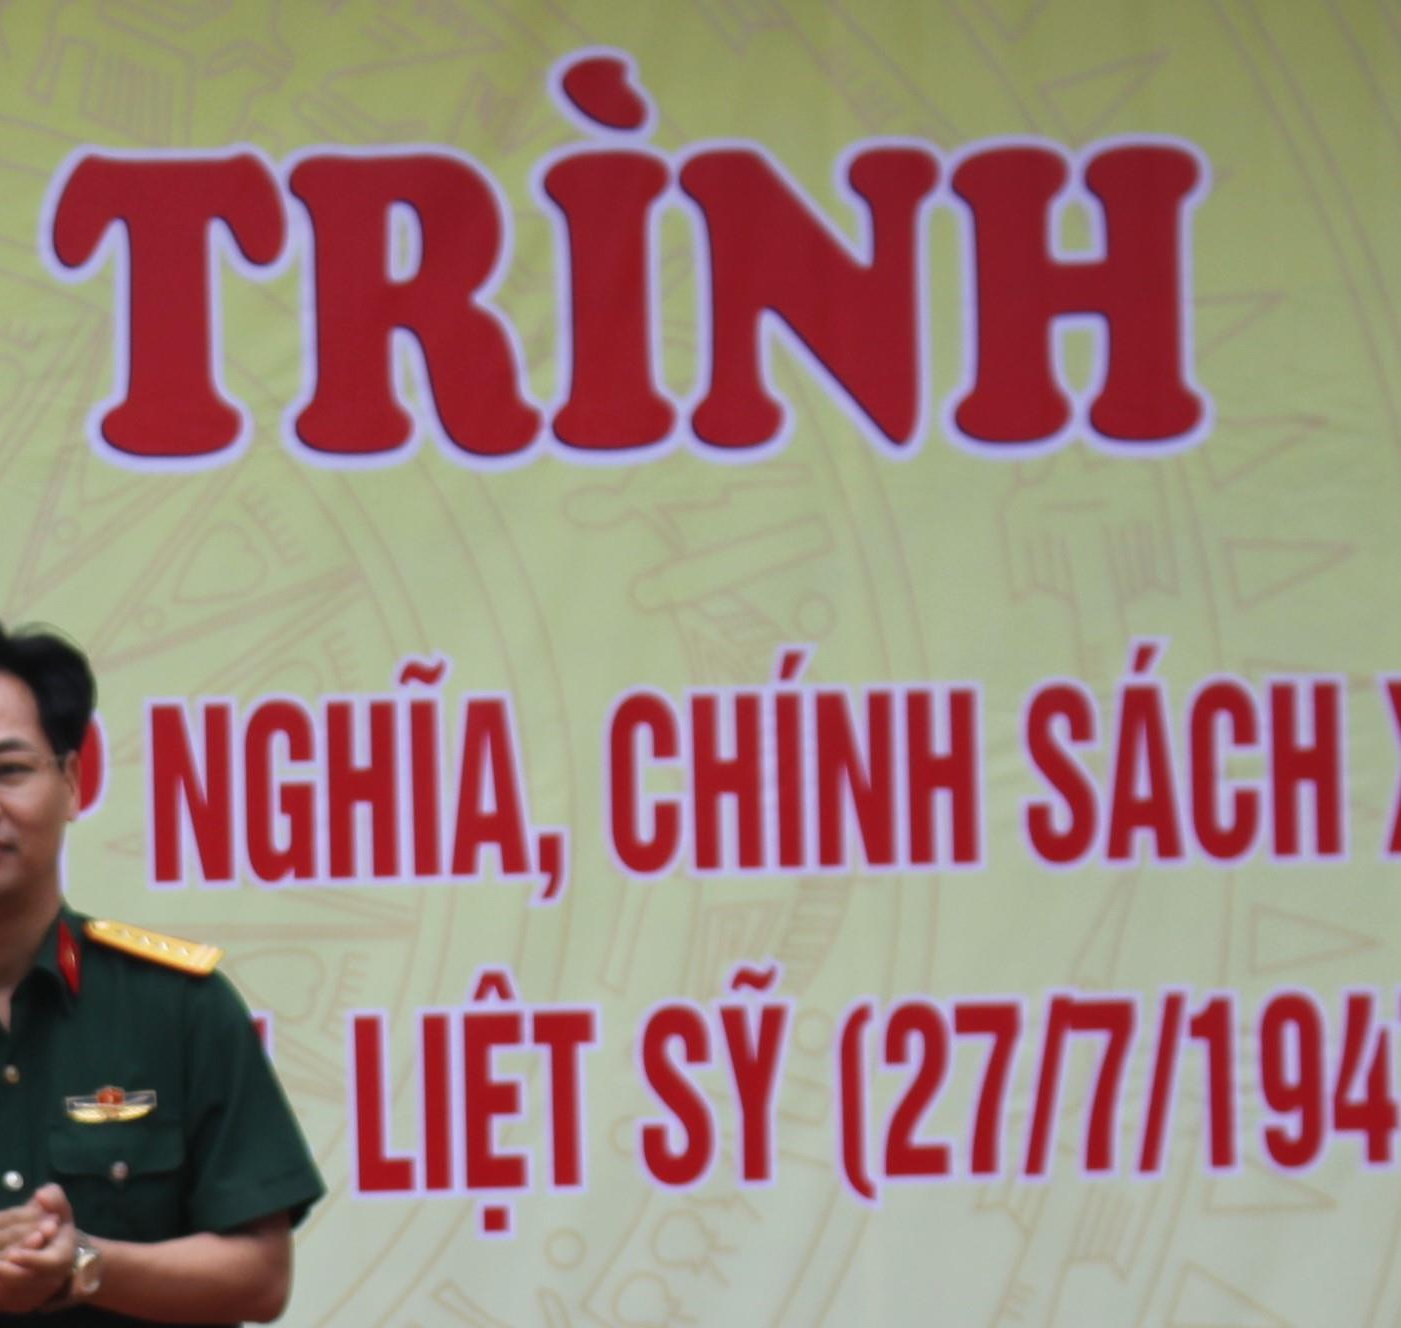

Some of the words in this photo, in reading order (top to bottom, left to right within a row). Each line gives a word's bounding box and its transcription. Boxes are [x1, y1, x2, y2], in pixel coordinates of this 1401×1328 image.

[52, 56, 1204, 458] TRÌNH
[149, 660, 564, 900] NGHĨA,
[608, 650, 980, 876] CHÍNH
[1025, 643, 1343, 866] SÁCH
[351, 970, 595, 1235] LIỆT
[640, 966, 787, 1188] SỸ
[838, 992, 1401, 1201] (27/7/194
